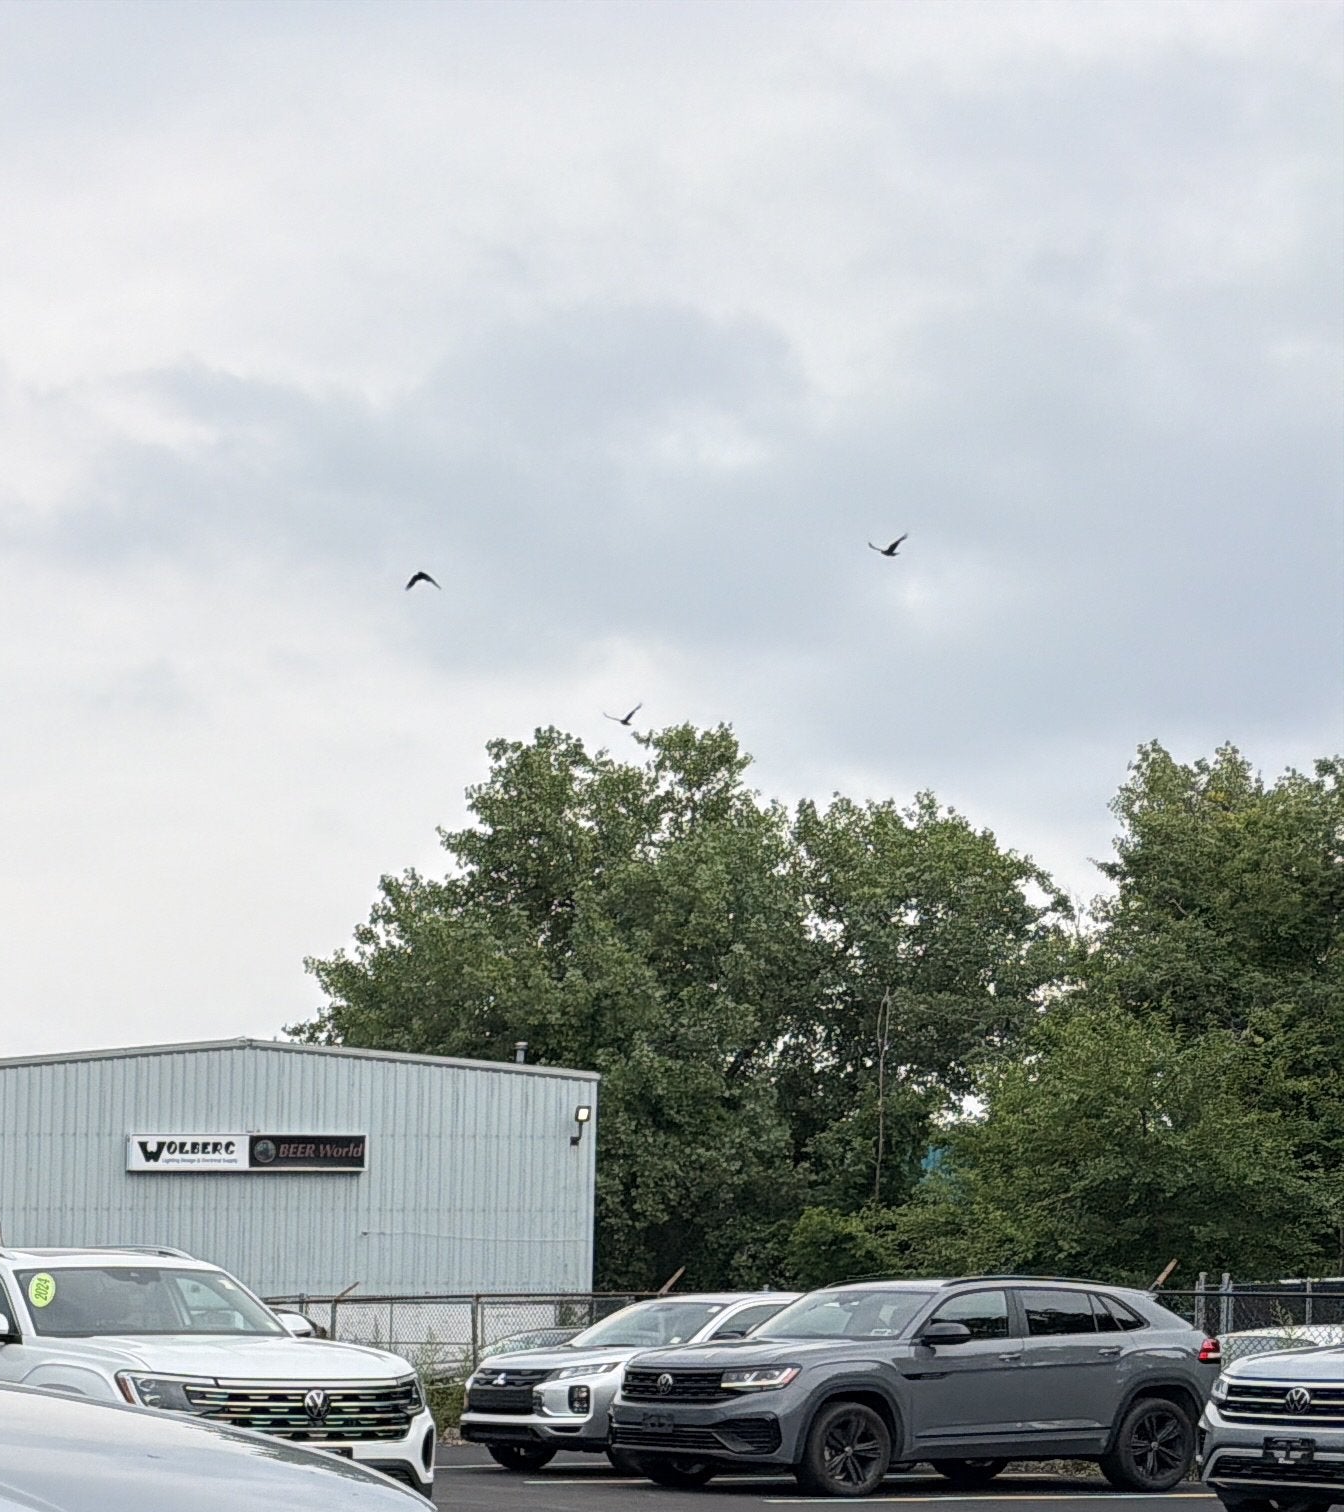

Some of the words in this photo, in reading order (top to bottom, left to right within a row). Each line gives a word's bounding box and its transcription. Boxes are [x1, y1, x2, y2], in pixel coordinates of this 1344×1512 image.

[137, 1140, 236, 1162] WOLBERG
[278, 1143, 315, 1158] BEER
[318, 1142, 363, 1158] World
[34, 1277, 51, 1301] 2024
